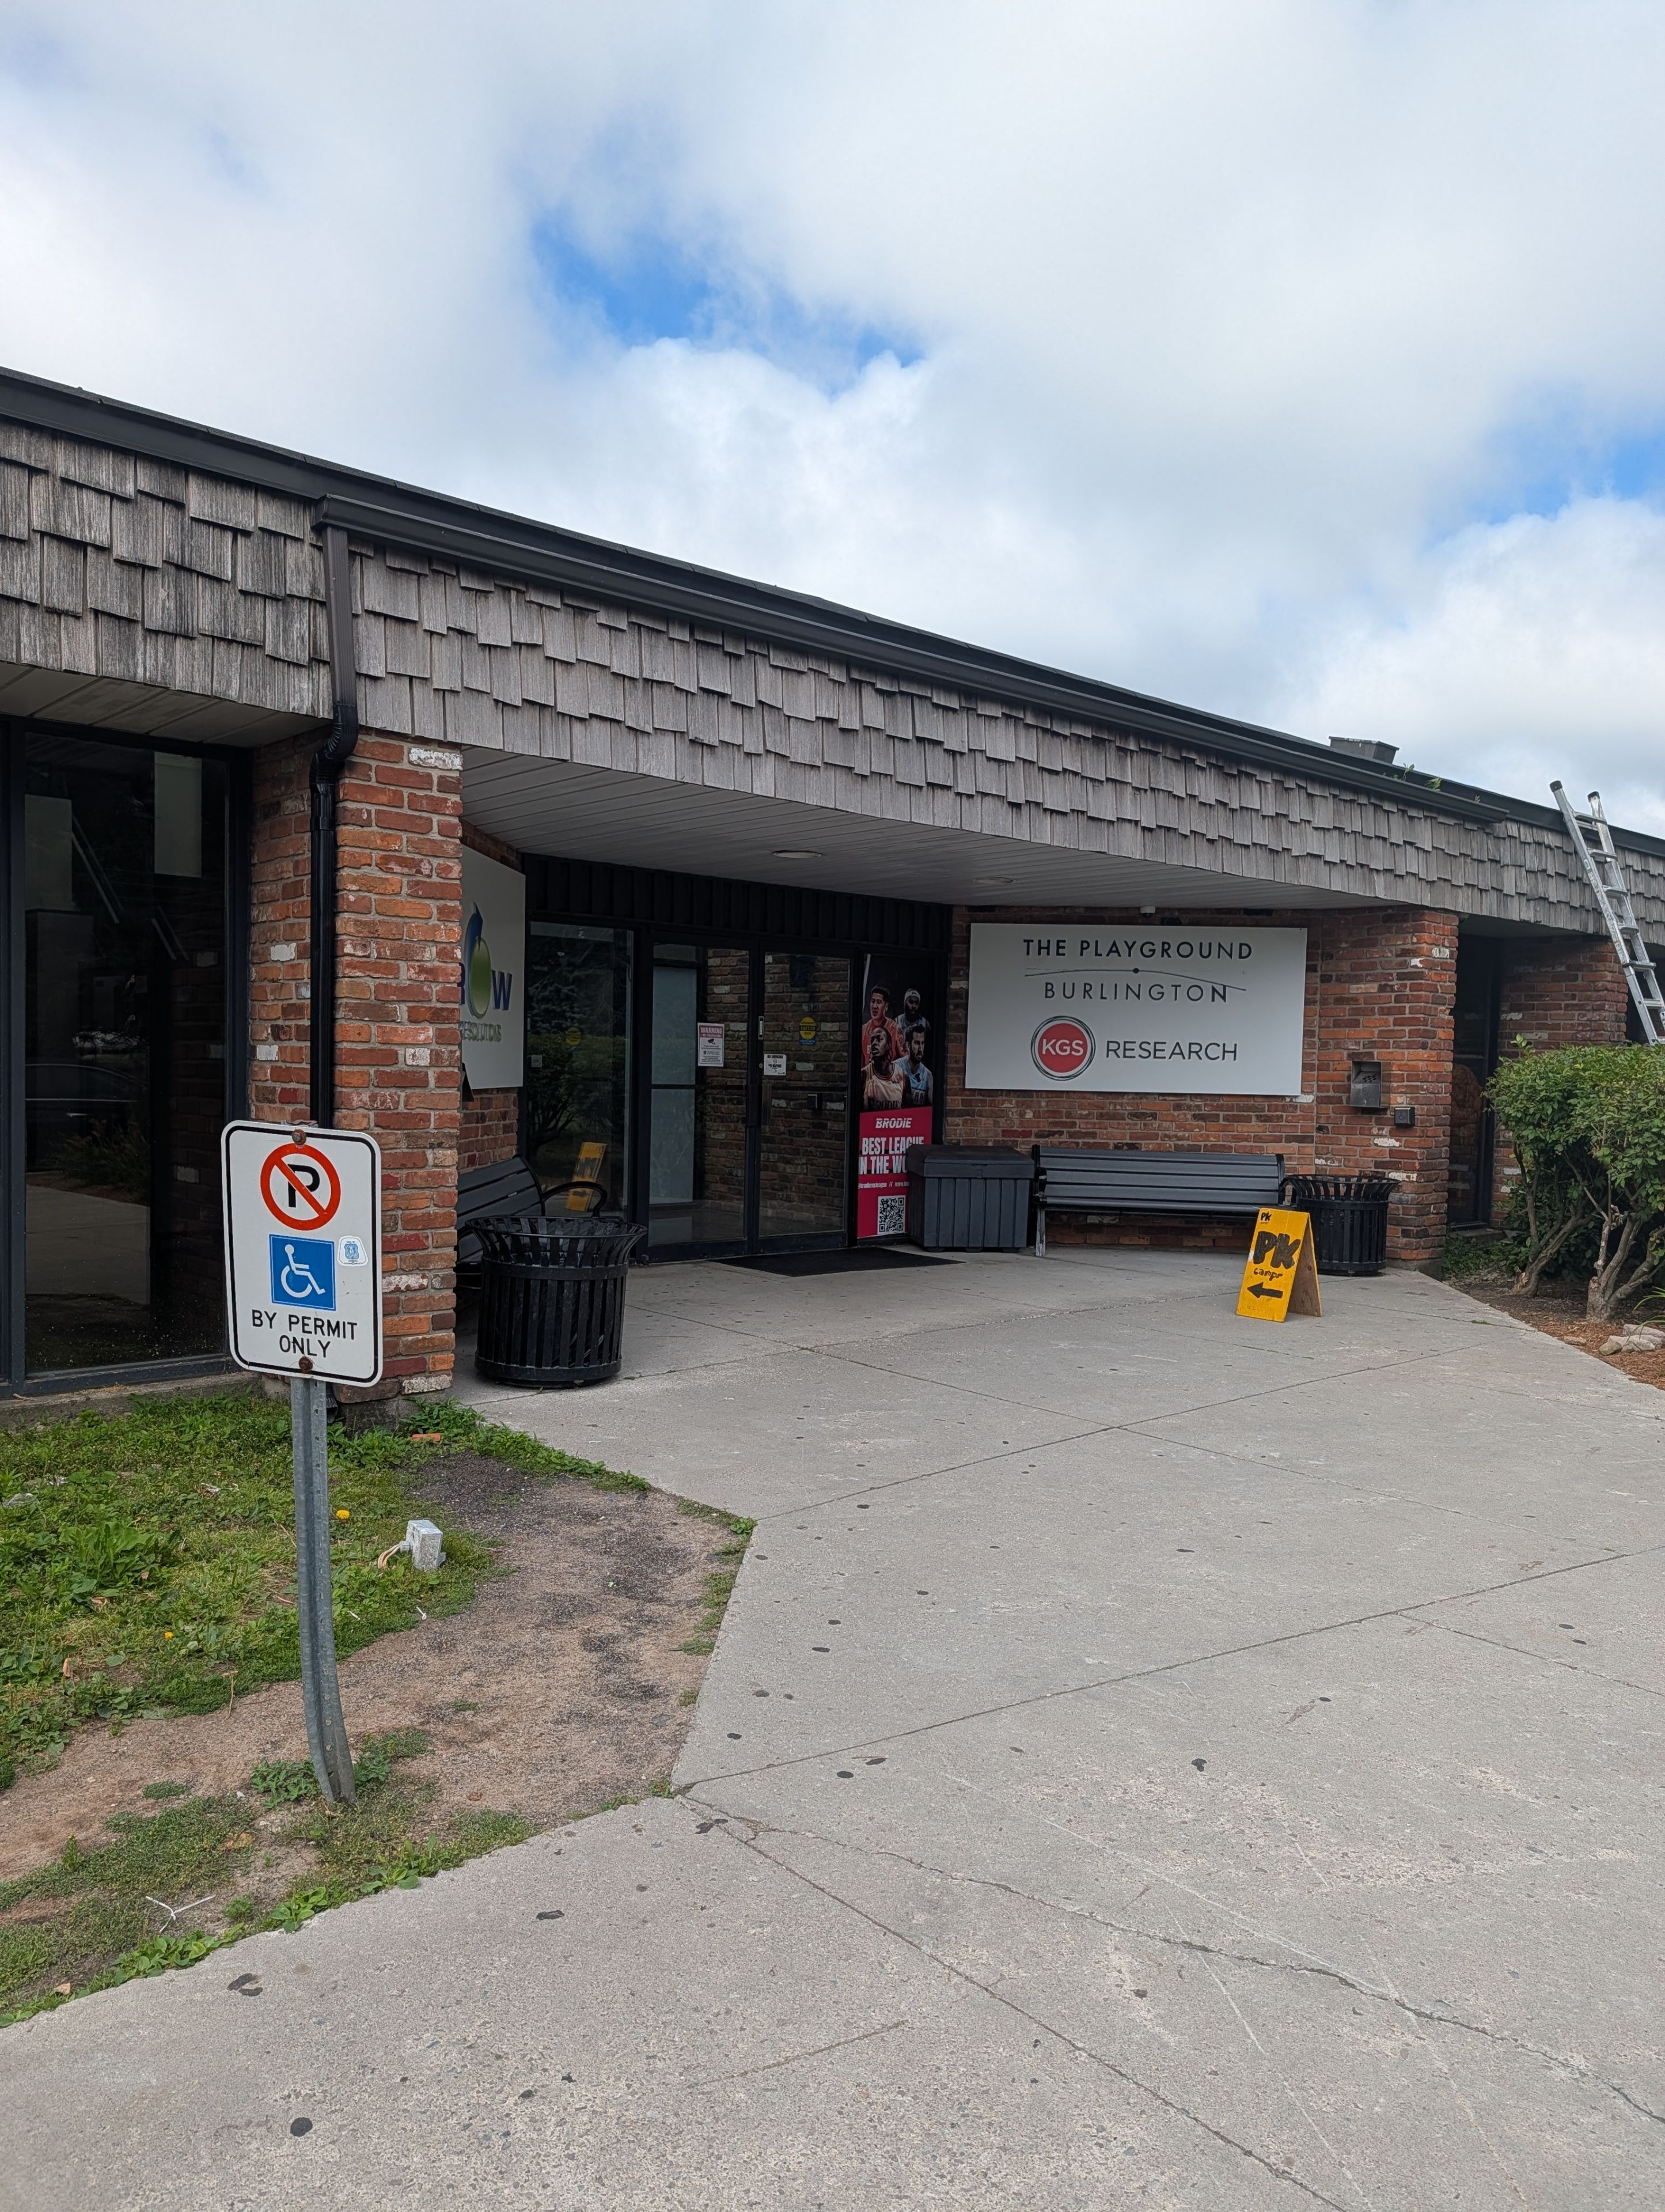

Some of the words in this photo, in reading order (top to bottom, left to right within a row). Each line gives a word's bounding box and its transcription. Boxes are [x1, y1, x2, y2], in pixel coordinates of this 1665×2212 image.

[1023, 938, 1067, 957] THE
[1080, 940, 1253, 960] PLAYGROUND
[1044, 982, 1227, 1003] BURLINGTON
[1042, 1038, 1084, 1056] KGS
[1105, 1040, 1238, 1062] RESEARCH
[875, 1118, 912, 1129] BRODIE
[862, 1137, 886, 1155] BEST
[870, 1156, 889, 1174] THE
[1260, 1211, 1272, 1222] PK
[1253, 1230, 1301, 1270] PK
[252, 1309, 277, 1330] BY
[288, 1314, 358, 1340] PERMIT
[279, 1335, 331, 1358] ONLY
